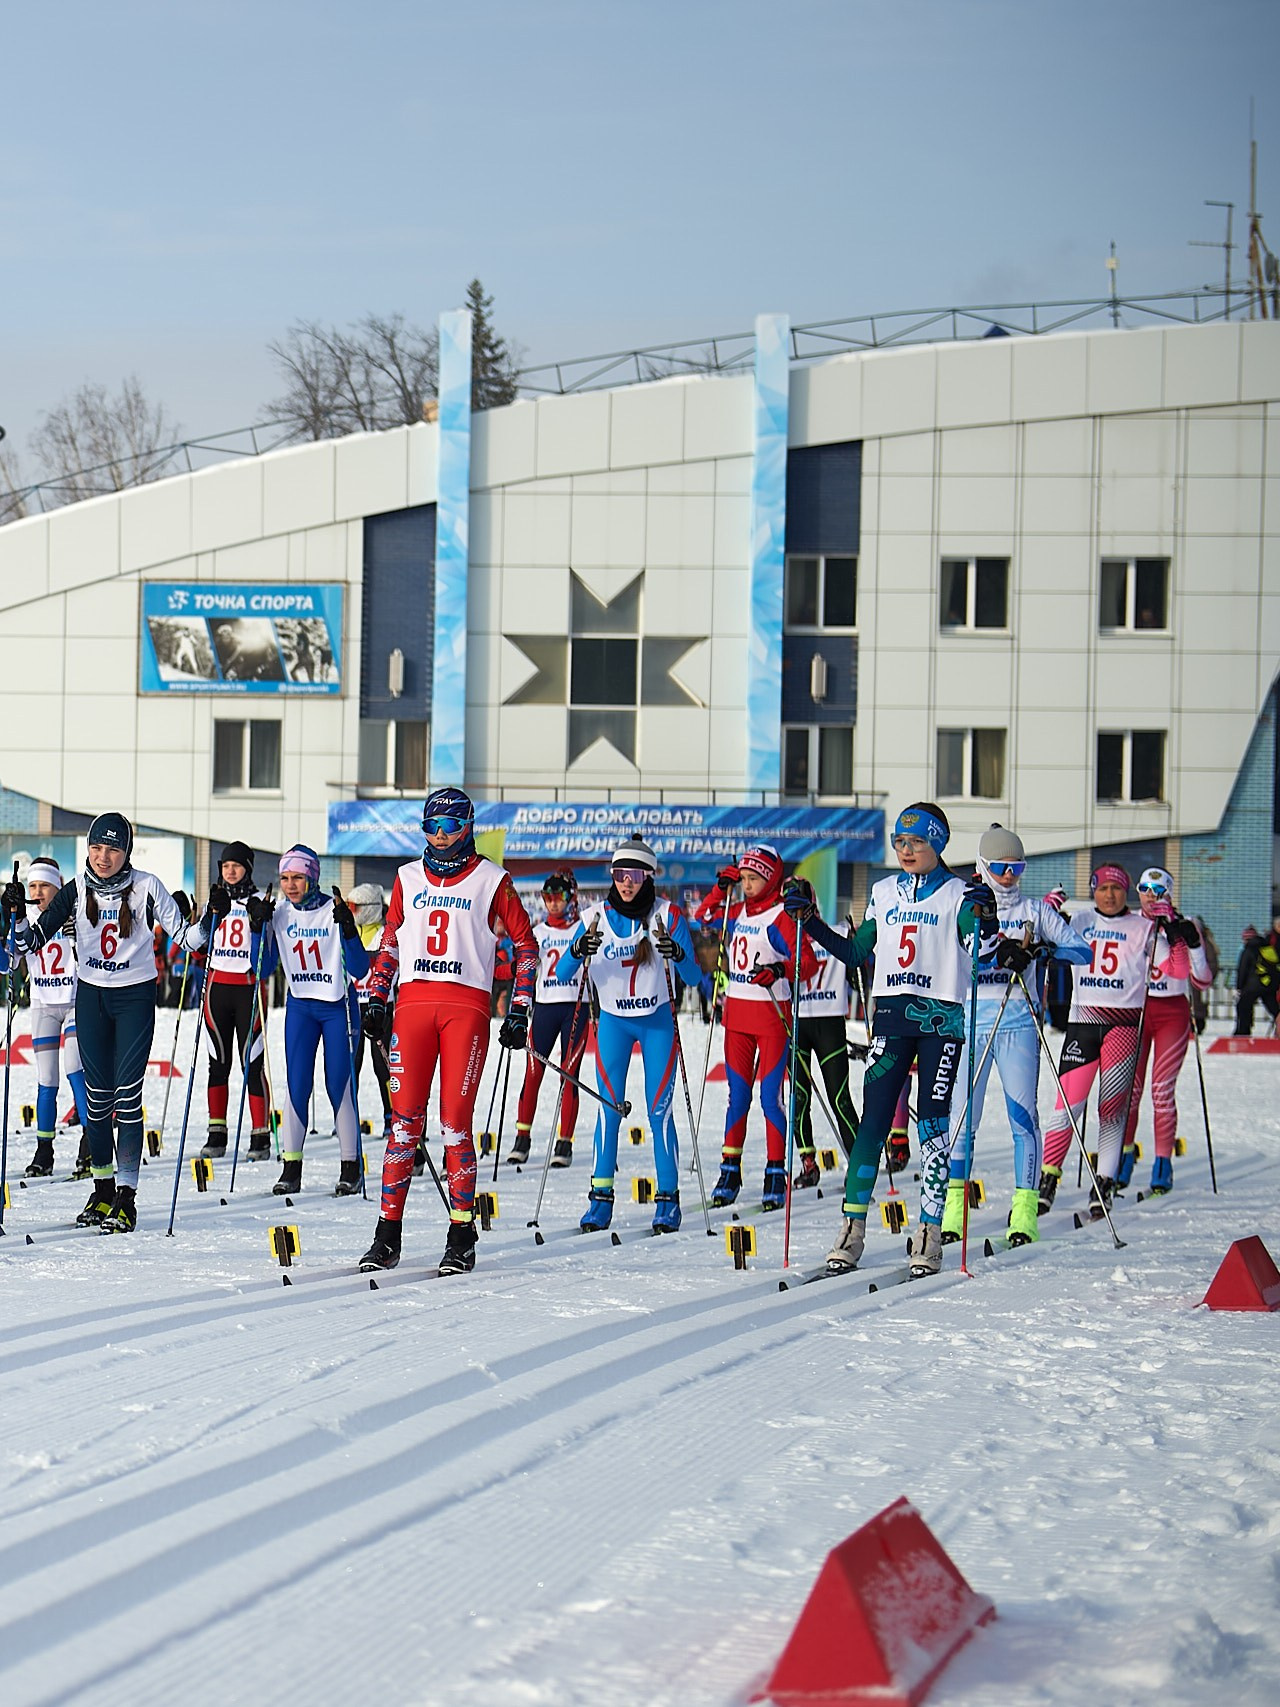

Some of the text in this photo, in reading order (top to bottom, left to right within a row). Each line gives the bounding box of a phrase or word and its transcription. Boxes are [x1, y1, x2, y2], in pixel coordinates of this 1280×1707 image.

[194, 595, 314, 610] ТОЧКА СПОРТА
[513, 807, 703, 826] ДОБРО ПОЖАЛОВАТЬ
[511, 824, 557, 835] ЛЫЖНЫМ
[427, 895, 472, 911] ГАЗПРОМ
[898, 911, 939, 926] ГАЗПРОМ
[101, 923, 118, 960] 6
[218, 918, 244, 948] 18
[298, 927, 329, 938] ГАЗПРОМ
[426, 910, 450, 957] 3
[1094, 930, 1127, 941] ГАЗПРОМ
[550, 939, 572, 947] ГАЗПР
[897, 925, 918, 969] 5
[35, 943, 65, 975] 12
[293, 940, 323, 971] 11
[732, 936, 749, 970] 13
[1089, 941, 1119, 976] 15
[34, 976, 74, 988] ИЖЕВСК
[291, 973, 333, 984] ИЖЕВСК
[621, 959, 640, 997] 7
[886, 972, 933, 989] ИЖЕВСК
[1080, 976, 1125, 990] ИЖЕВСК
[461, 1035, 479, 1096] СВЕРДЛОВСКАЯ
[471, 1048, 482, 1084] ОБЛАСТЬ
